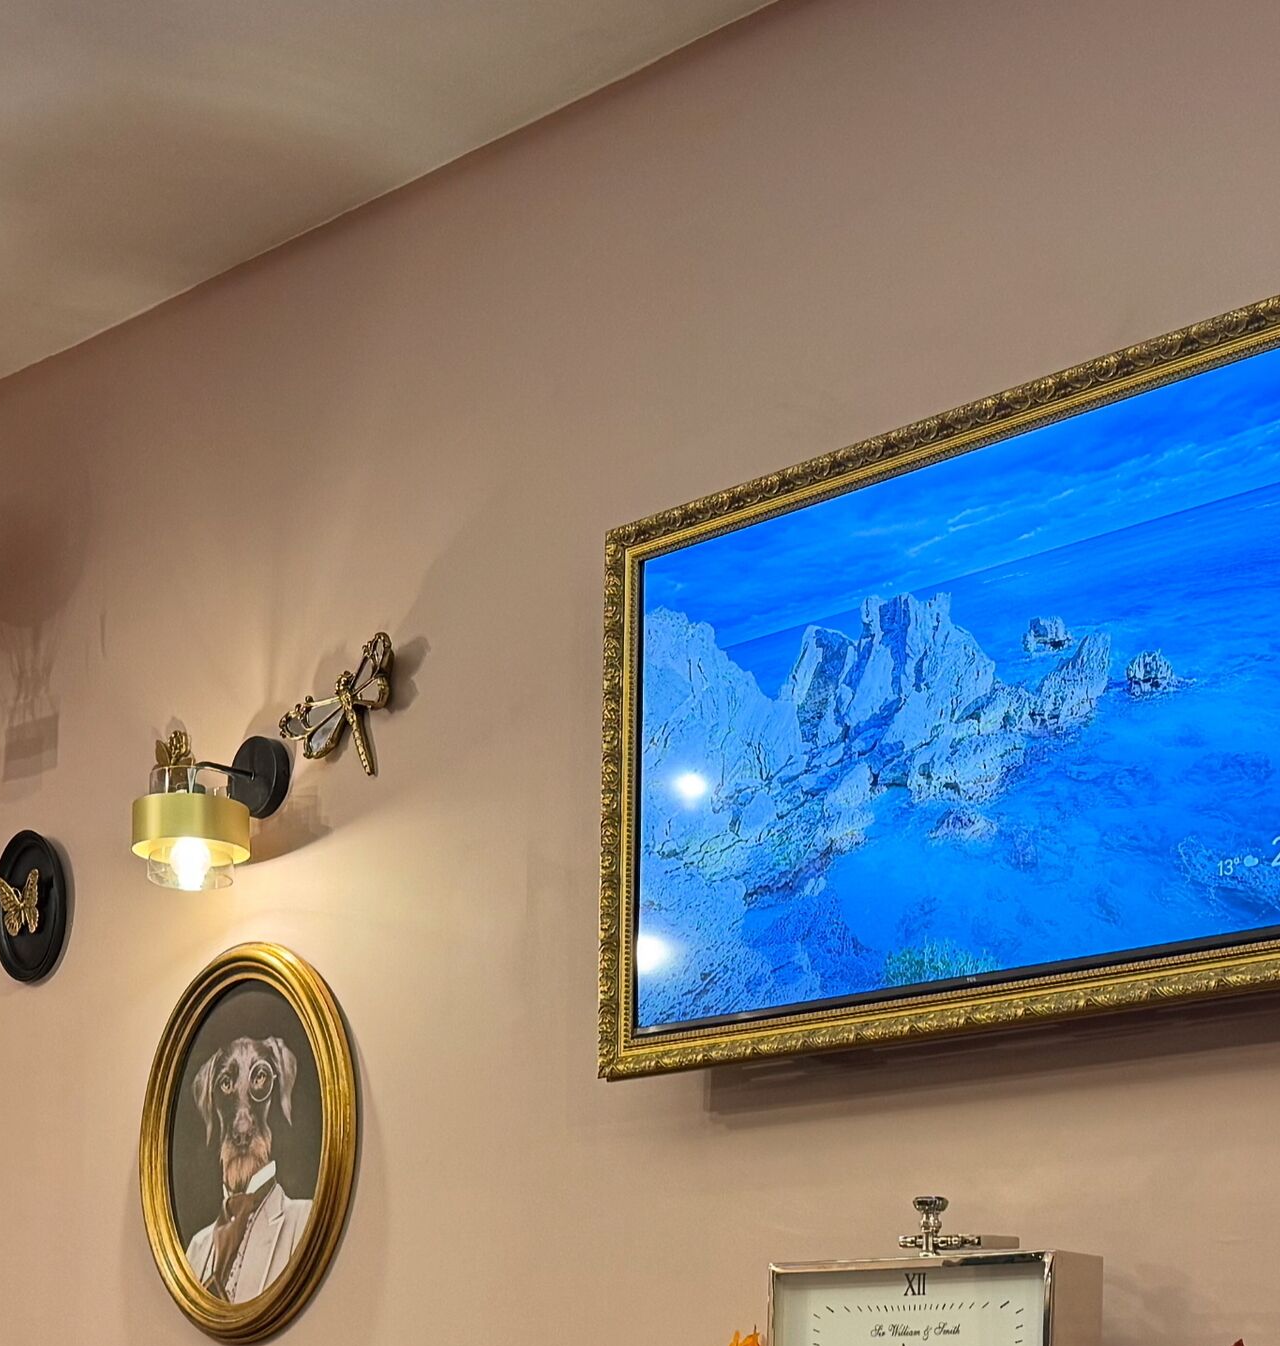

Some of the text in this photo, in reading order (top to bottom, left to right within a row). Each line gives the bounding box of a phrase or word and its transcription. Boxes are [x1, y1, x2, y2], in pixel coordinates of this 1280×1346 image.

[903, 1272, 927, 1297] XII
[870, 1321, 961, 1341] Sir William & Smith
